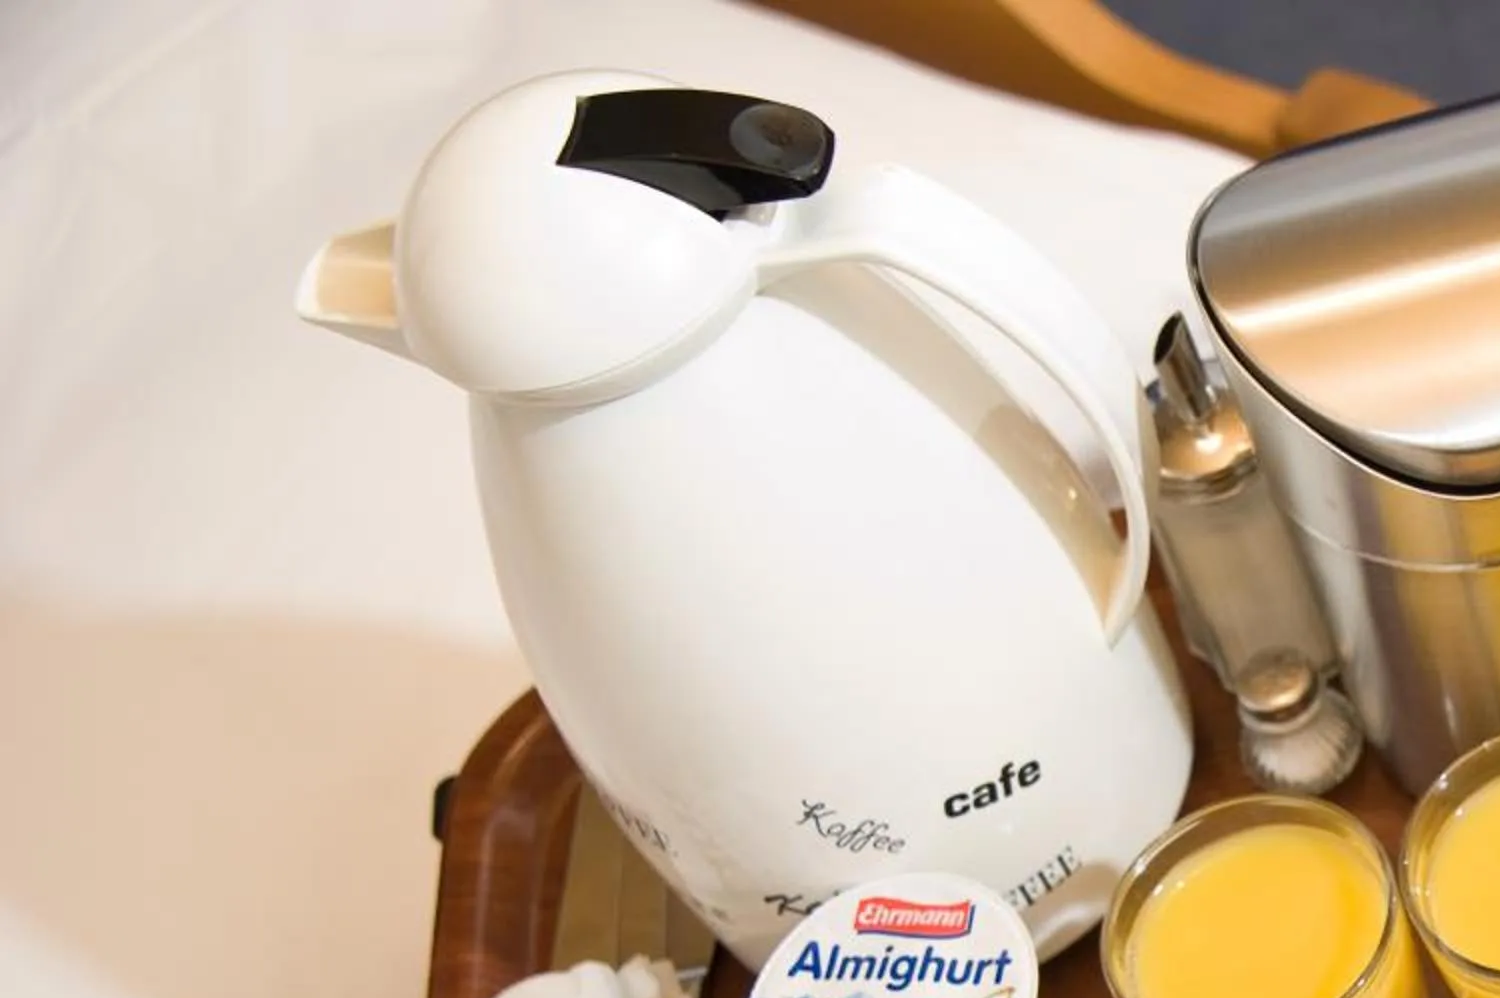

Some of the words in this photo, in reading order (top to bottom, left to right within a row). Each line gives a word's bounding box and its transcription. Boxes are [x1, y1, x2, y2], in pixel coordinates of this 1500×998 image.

[944, 759, 1041, 819] cafe
[856, 901, 967, 929] Ehrmann
[787, 940, 1014, 991] Almighurt
